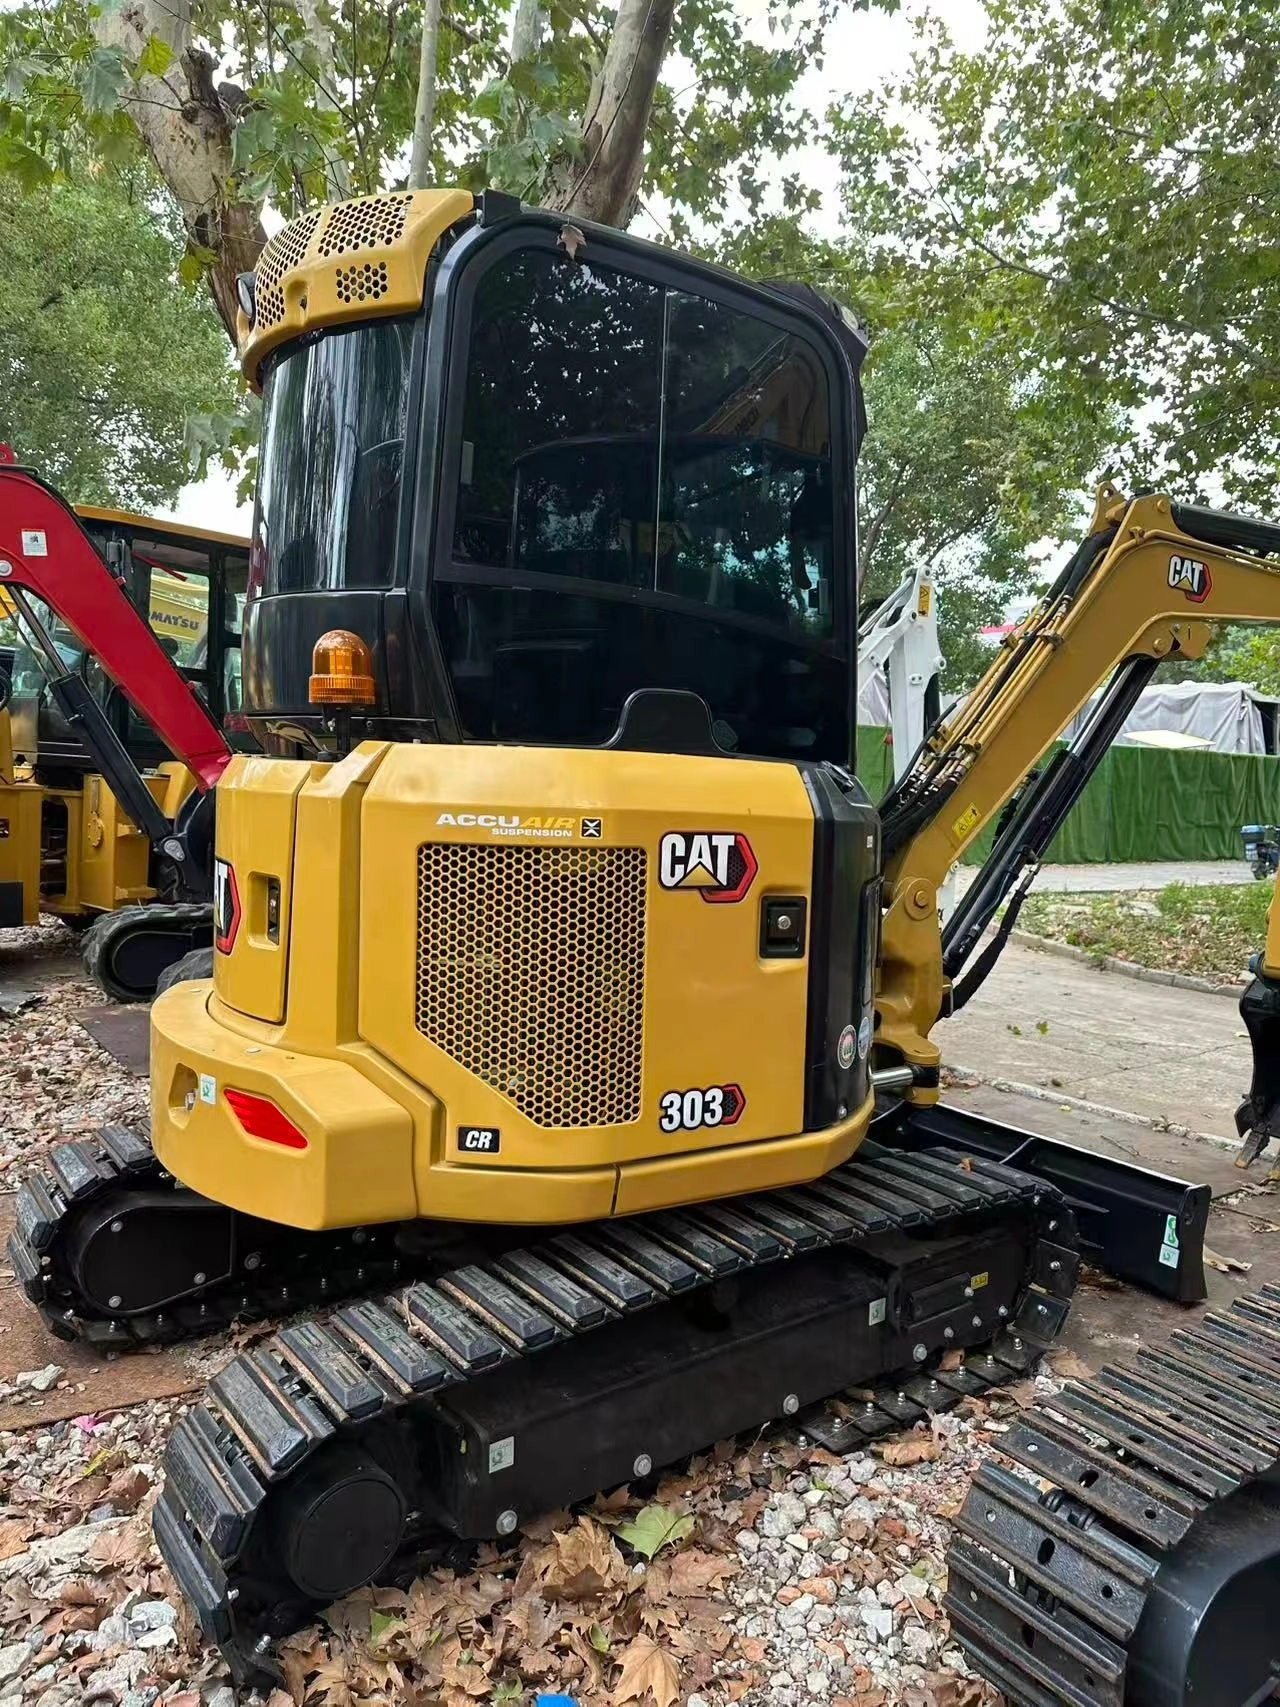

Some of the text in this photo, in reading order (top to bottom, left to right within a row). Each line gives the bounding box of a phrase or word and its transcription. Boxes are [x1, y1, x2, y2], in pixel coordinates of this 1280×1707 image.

[1168, 556, 1204, 593] CAT
[151, 611, 200, 631] MATSU
[491, 827, 573, 838] SUSPENSION
[660, 833, 736, 888] CAT
[661, 1087, 724, 1131] 303
[465, 1130, 493, 1149] CR
